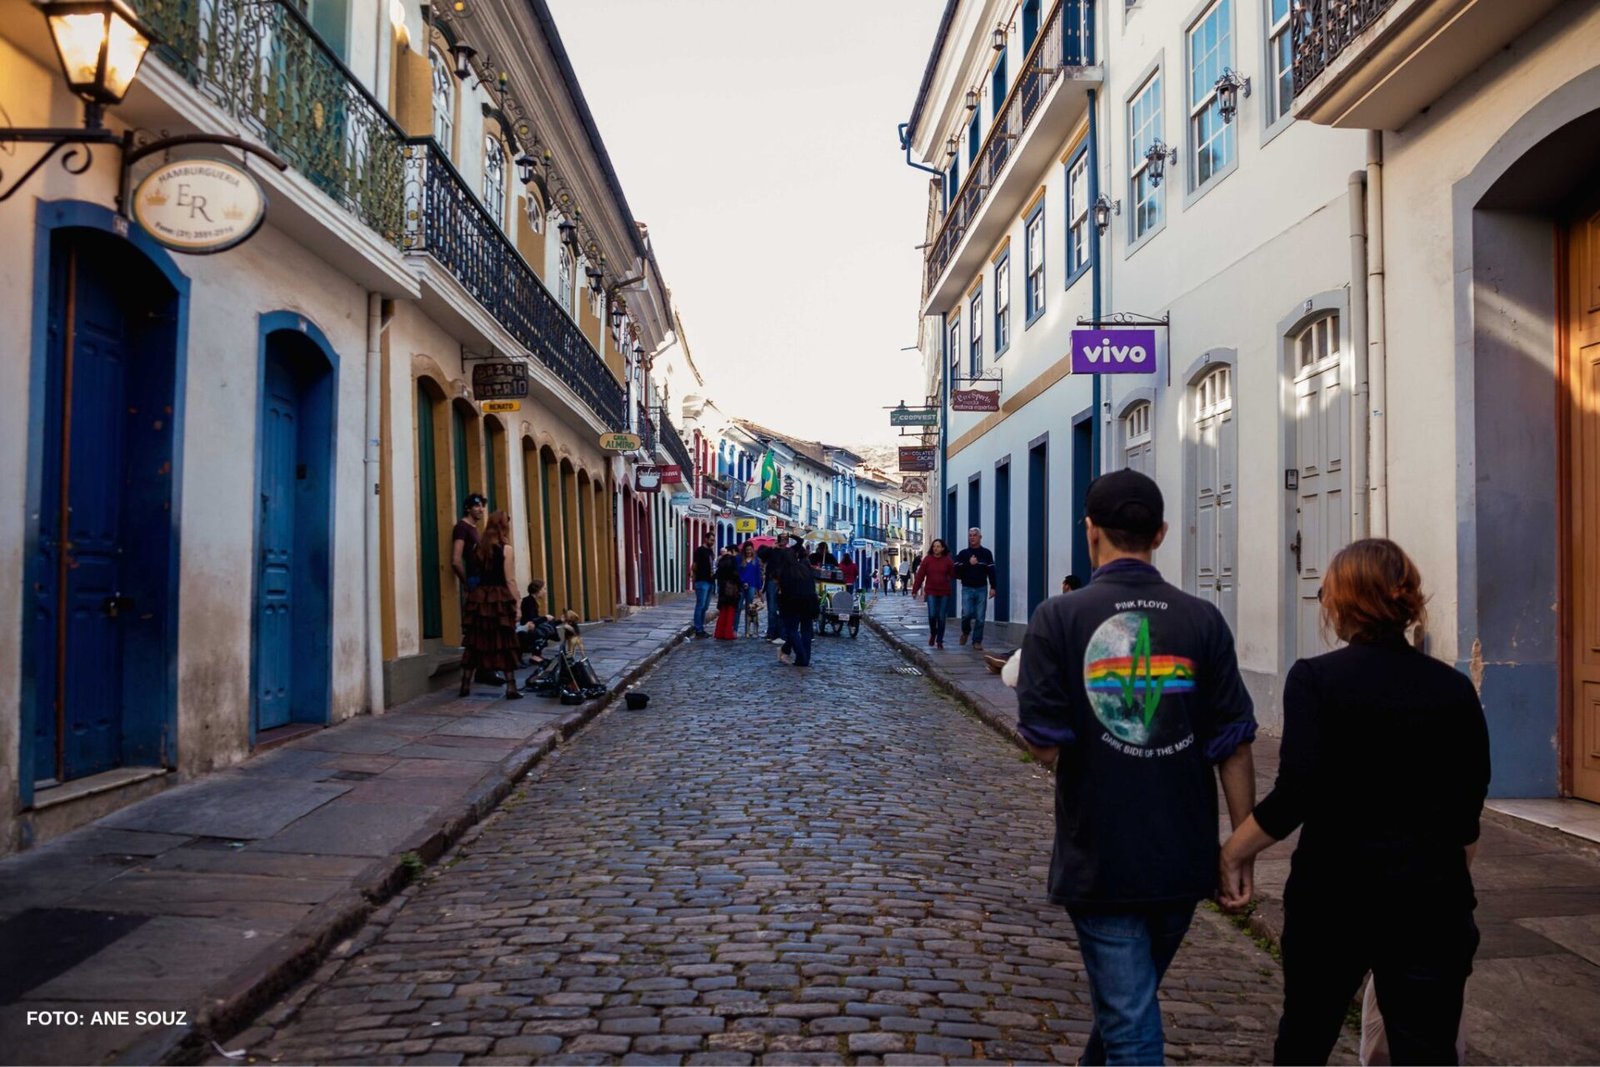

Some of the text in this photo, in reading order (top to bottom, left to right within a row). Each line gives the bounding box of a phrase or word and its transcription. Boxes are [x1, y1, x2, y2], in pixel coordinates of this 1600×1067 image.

[158, 166, 240, 187] HAMBURGUERIA
[176, 183, 215, 223] ER
[1082, 338, 1147, 363] vivo
[605, 440, 635, 449] ALMIRO
[1115, 599, 1168, 611] PINK FLOYD
[1101, 732, 1122, 751] DARK
[1123, 745, 1143, 757] SIDE
[1144, 748, 1154, 757] OF
[1155, 746, 1174, 757] THE
